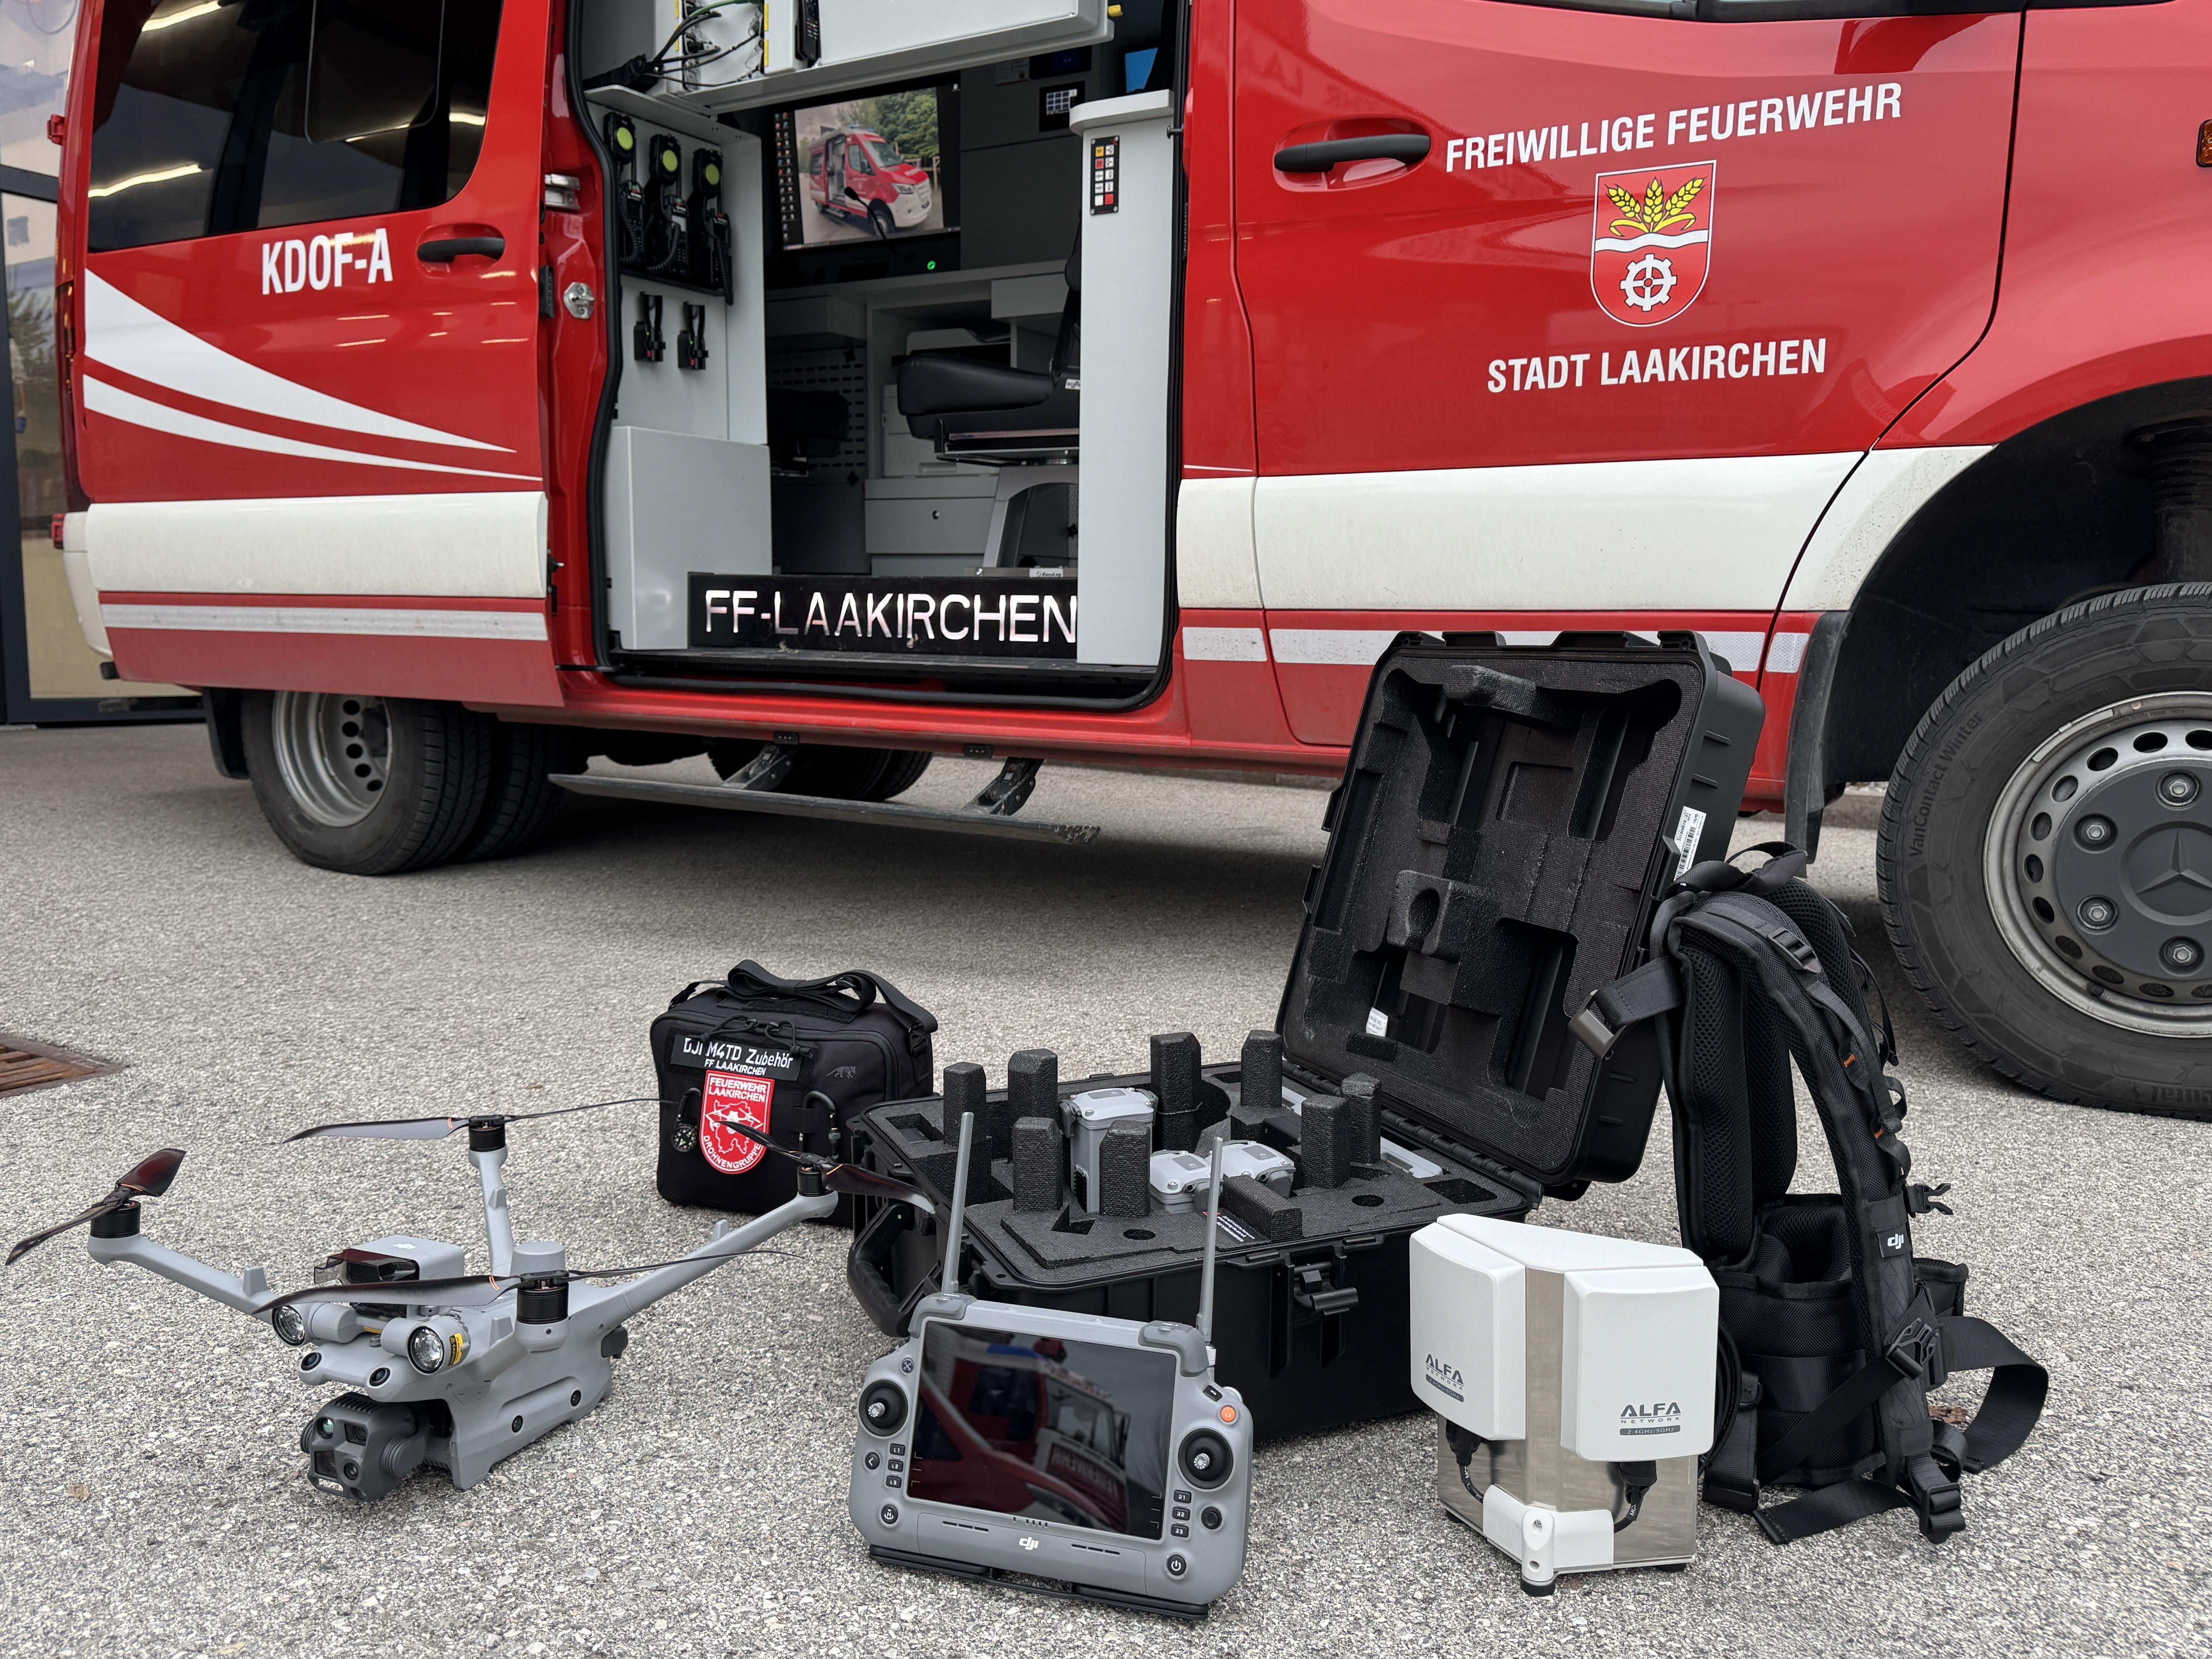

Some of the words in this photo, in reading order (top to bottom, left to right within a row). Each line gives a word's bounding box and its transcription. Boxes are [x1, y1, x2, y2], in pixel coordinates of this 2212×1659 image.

[1446, 113, 1656, 172] FREIWILLIGE
[1667, 82, 1902, 145] FEUERWEHR
[261, 227, 393, 296] KDOF-A
[1487, 353, 1590, 393] STADT
[1601, 338, 1827, 386] LAAKIRCHEN
[706, 589, 1077, 644] FF-LAAKIRCHEN
[1909, 763, 1948, 858] VanContact
[1938, 711, 1983, 763] Winter
[683, 1037, 703, 1056] DJI
[705, 1041, 742, 1061] M4TD
[745, 1048, 793, 1069] Zubehör
[704, 1058, 715, 1068] FF
[715, 1061, 766, 1076] LAAKIRCHEN
[708, 1086, 766, 1103] LAAKIRCHEN
[709, 1077, 767, 1094] FEUERWEHR
[703, 1135, 762, 1169] DROHNENGRUPPE
[1425, 1353, 1464, 1385] ALFA
[1426, 1366, 1463, 1391] NETWORK
[1620, 1402, 1681, 1417] ALFA
